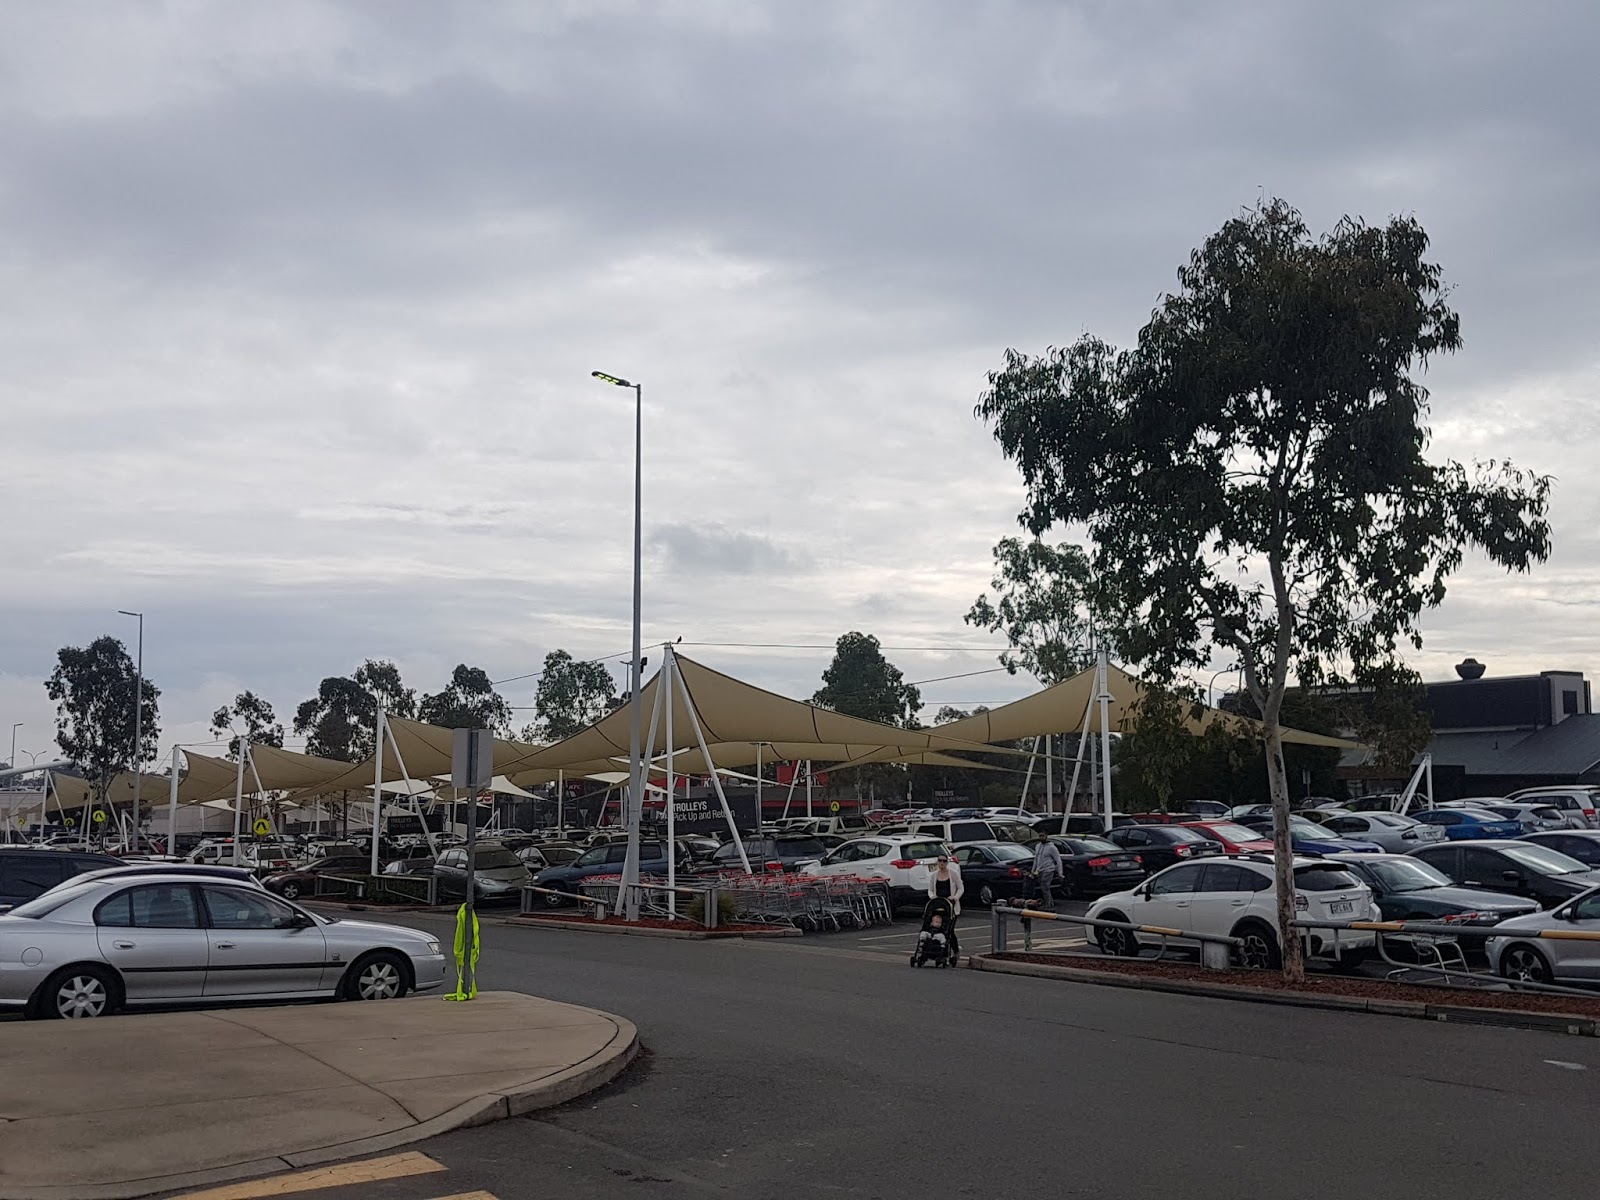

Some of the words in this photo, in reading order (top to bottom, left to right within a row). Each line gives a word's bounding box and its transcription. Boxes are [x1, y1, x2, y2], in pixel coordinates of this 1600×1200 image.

[673, 801, 707, 811] TROLLEYS
[673, 812, 688, 822] Pick
[687, 811, 698, 822] Up
[699, 810, 711, 820] and
[712, 809, 735, 818] Retun
